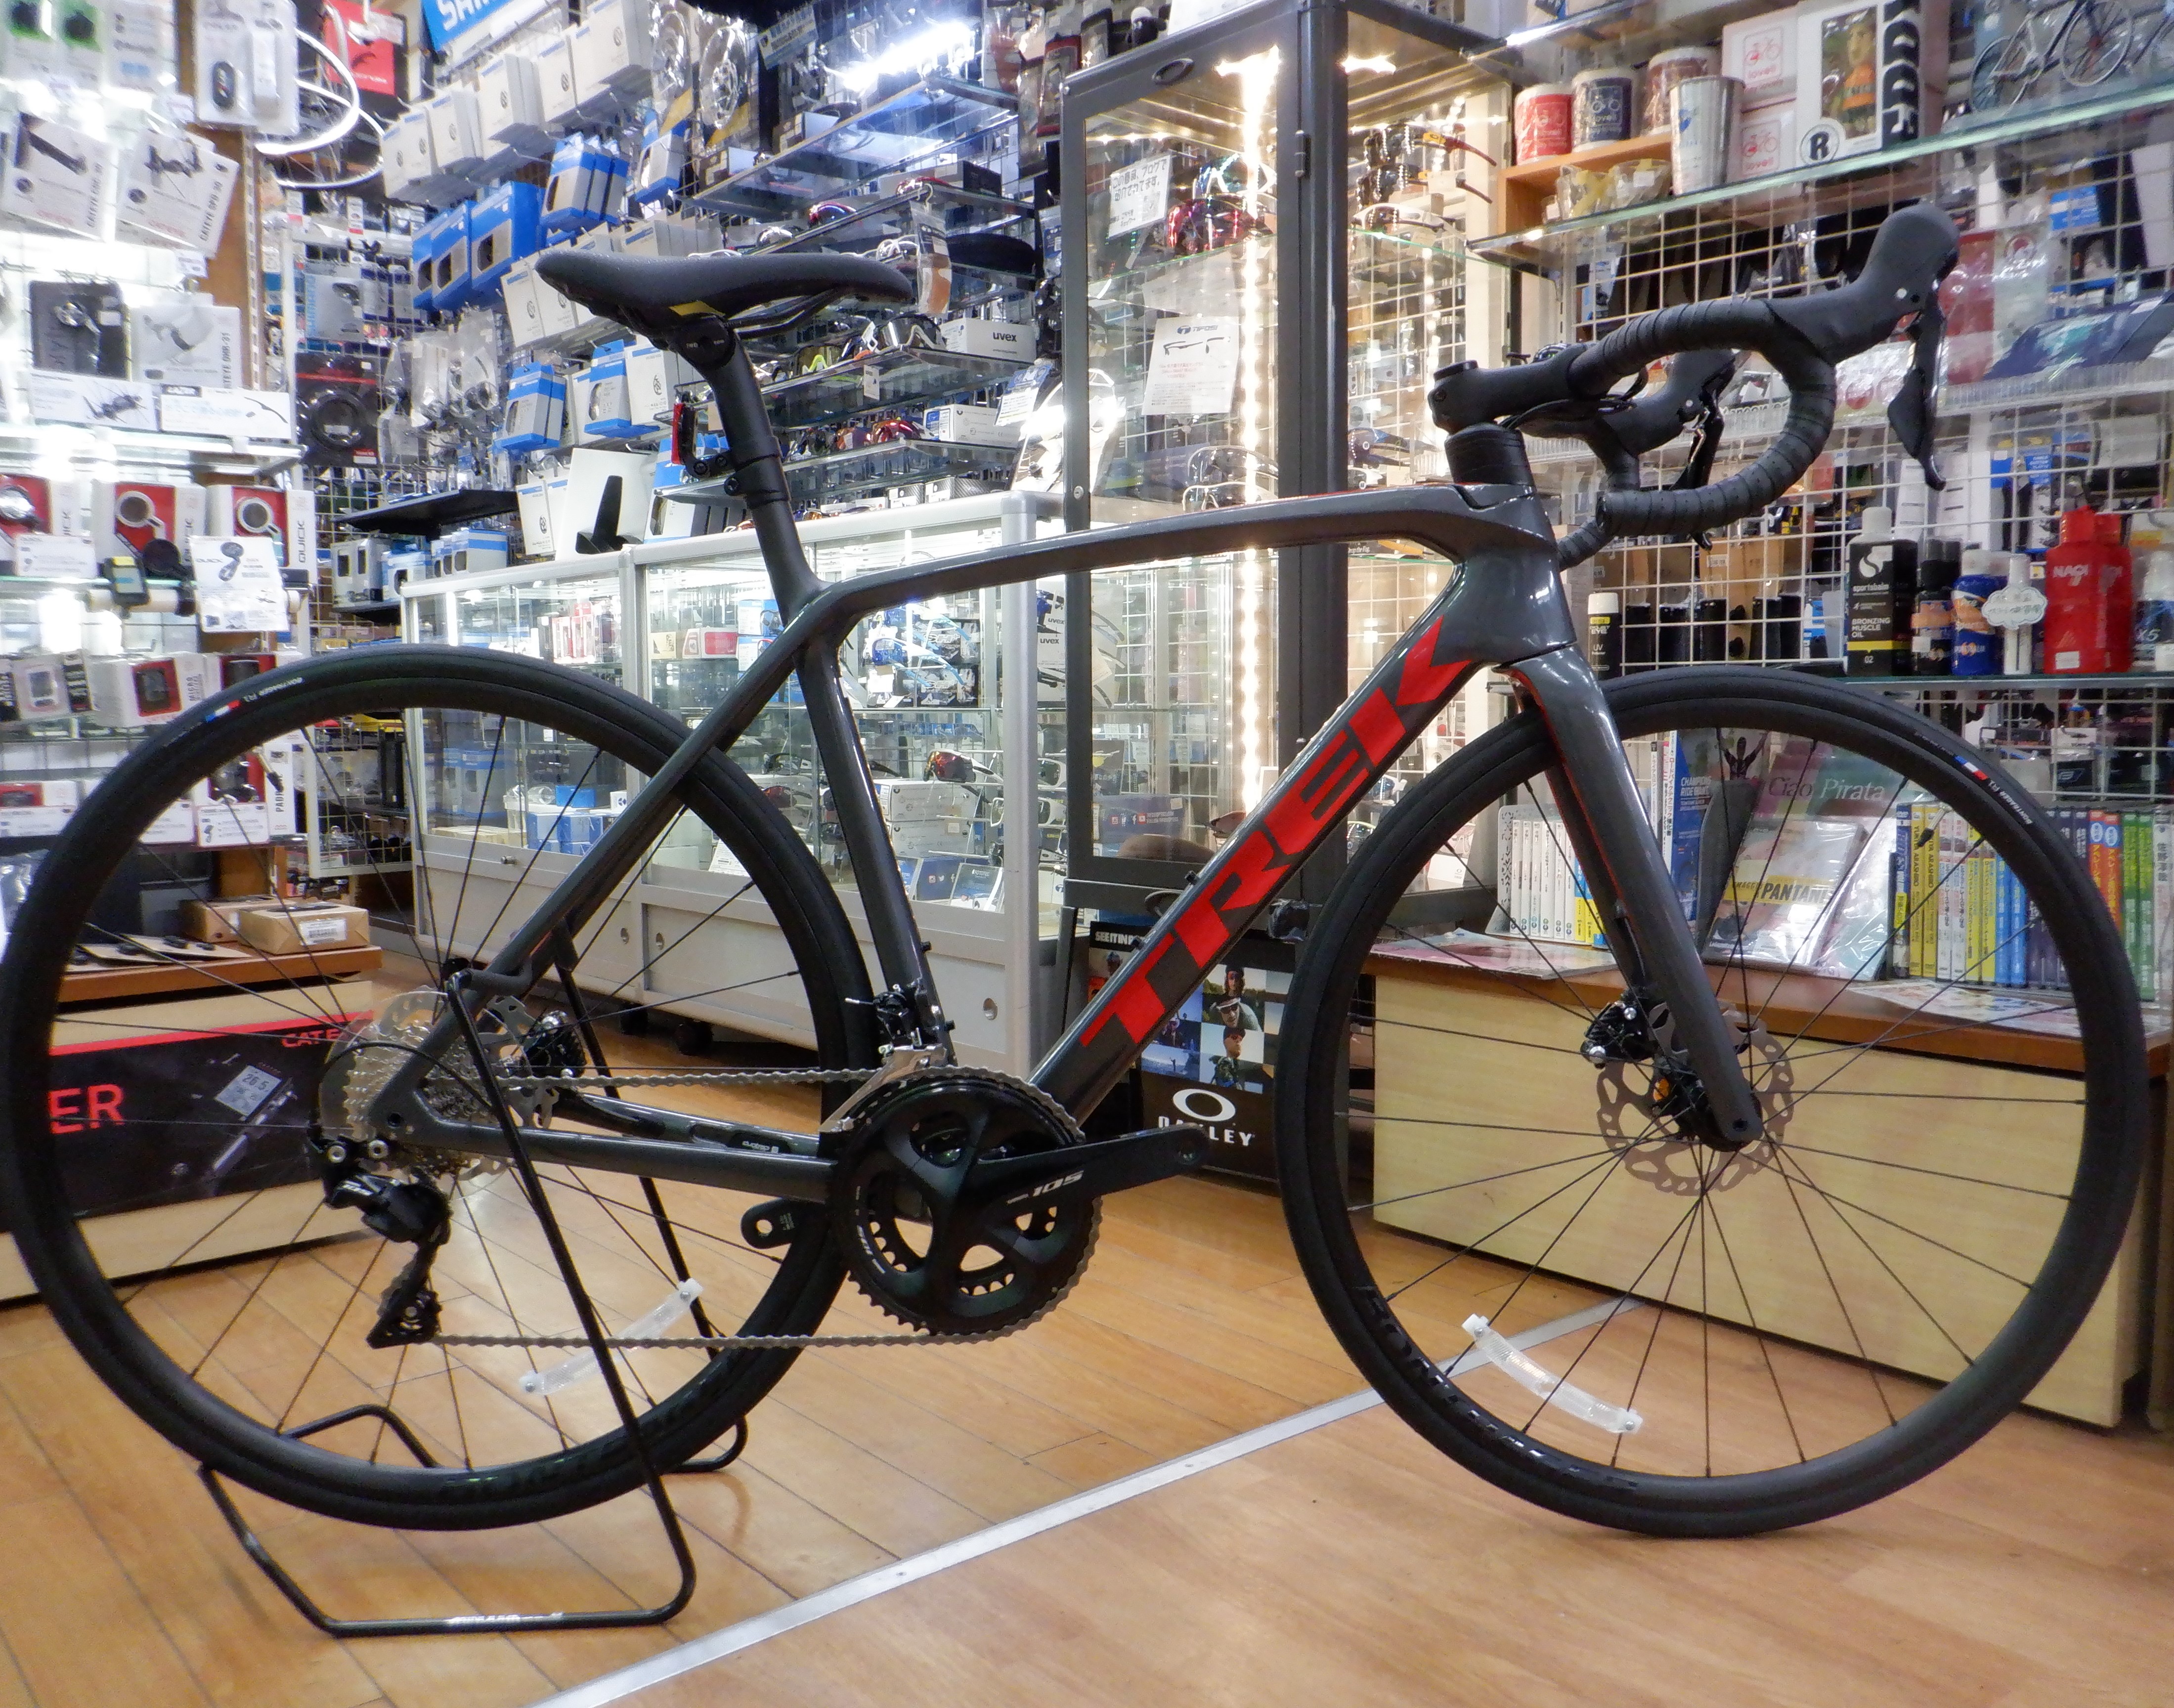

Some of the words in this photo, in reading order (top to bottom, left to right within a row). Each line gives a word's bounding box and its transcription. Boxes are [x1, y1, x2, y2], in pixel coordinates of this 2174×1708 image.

[993, 332, 1017, 342] uvex
[297, 520, 305, 563] QUICK
[1768, 777, 1814, 797] Ciao
[1819, 777, 1885, 801] Pirata
[1988, 780, 2001, 792] R1
[1998, 790, 2034, 825] BONTRAGER
[1079, 614, 1473, 1048] TREK
[1032, 1169, 1085, 1197] 105
